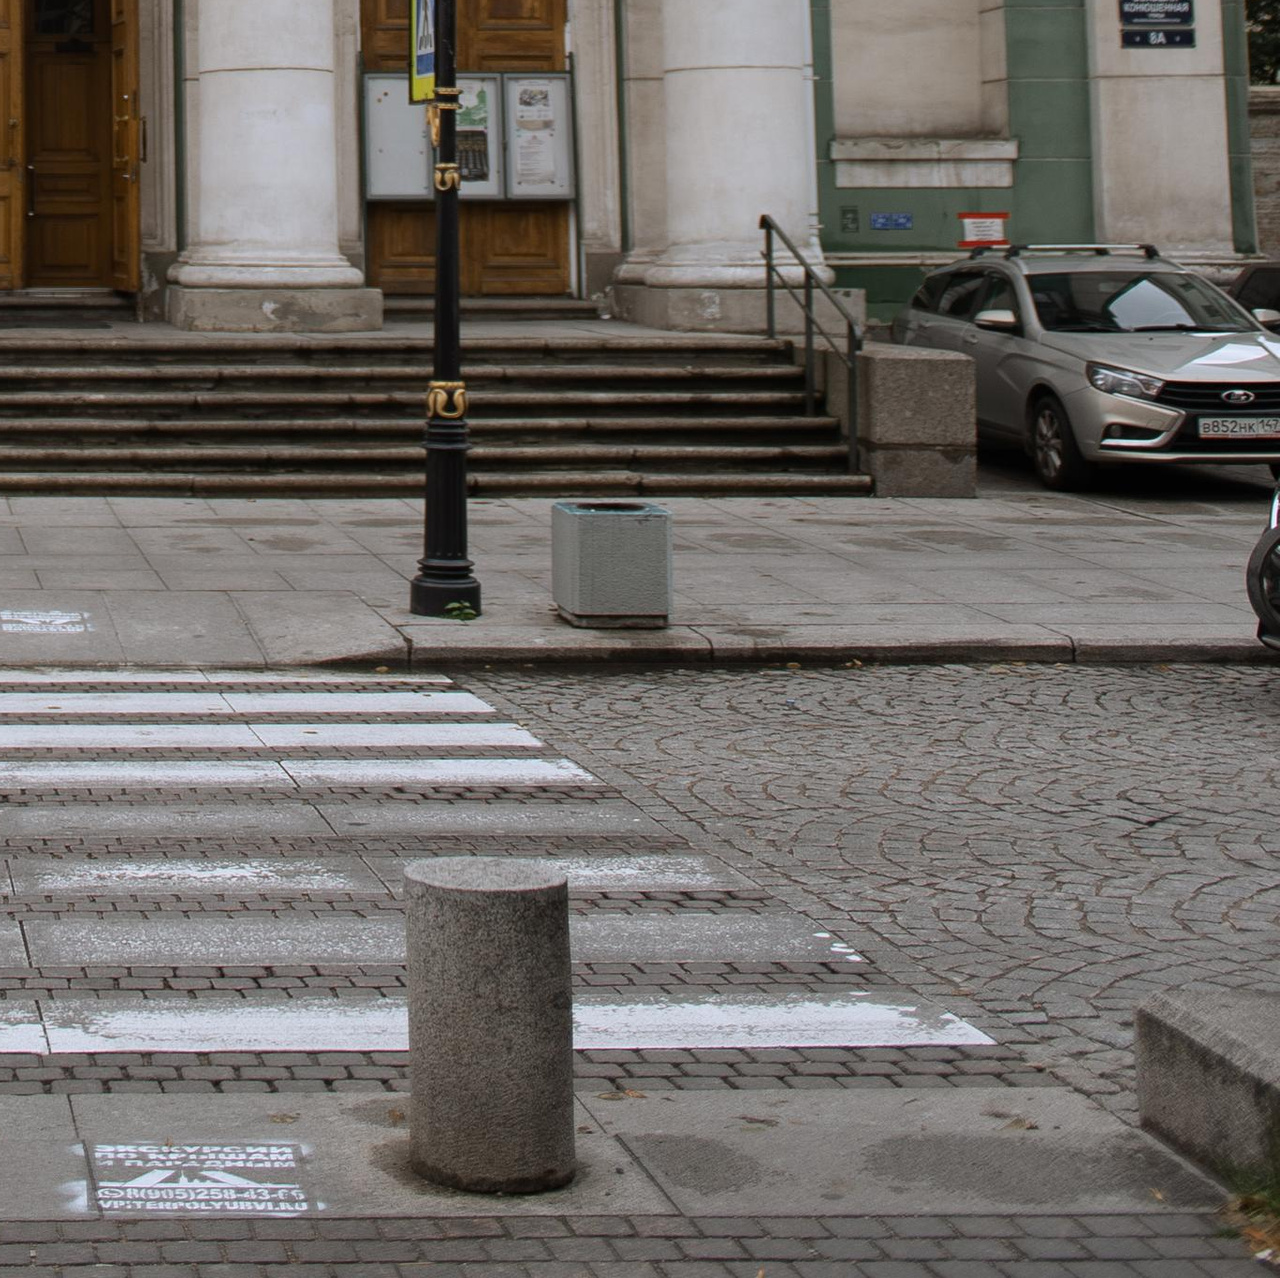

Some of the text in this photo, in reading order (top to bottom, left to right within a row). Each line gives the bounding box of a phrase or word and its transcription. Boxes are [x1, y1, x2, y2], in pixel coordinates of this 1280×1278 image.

[1123, 2, 1190, 13] КОНЮШЕННАЯ
[94, 1144, 293, 1153] ЭКСКУРСИИ
[95, 1152, 294, 1161] ПО КРЫШАМ
[125, 1159, 296, 1168] ПАРАДНЫМ
